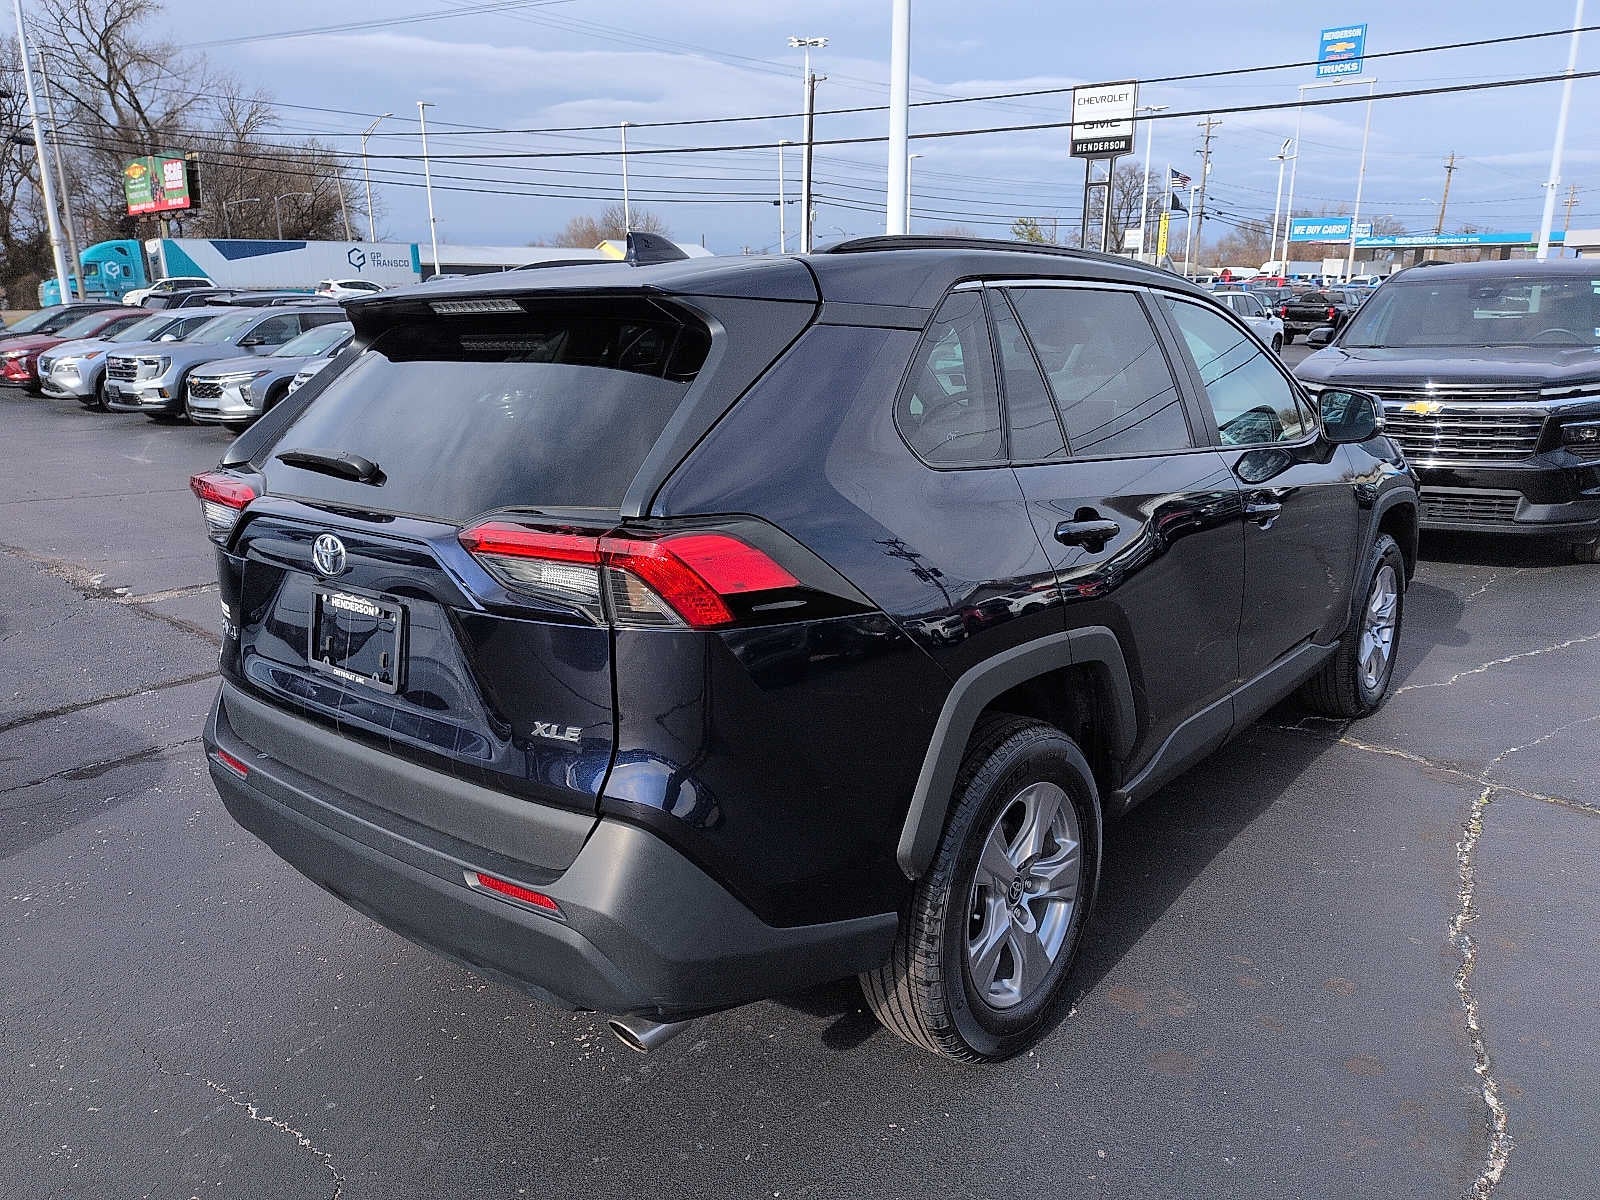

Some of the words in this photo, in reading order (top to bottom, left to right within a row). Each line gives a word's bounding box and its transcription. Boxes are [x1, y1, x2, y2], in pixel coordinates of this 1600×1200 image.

[1322, 28, 1362, 41] HENDERSON
[1319, 62, 1359, 75] TRUCKS
[1077, 93, 1129, 106] CHEVROLET
[1076, 140, 1126, 152] HENDERSON
[1293, 225, 1306, 235] WE
[1305, 225, 1323, 235] BUY
[1321, 224, 1348, 234] CARS!!
[371, 259, 410, 268] TRANSCO
[331, 597, 375, 617] HENDERSON
[530, 721, 583, 743] XLE
